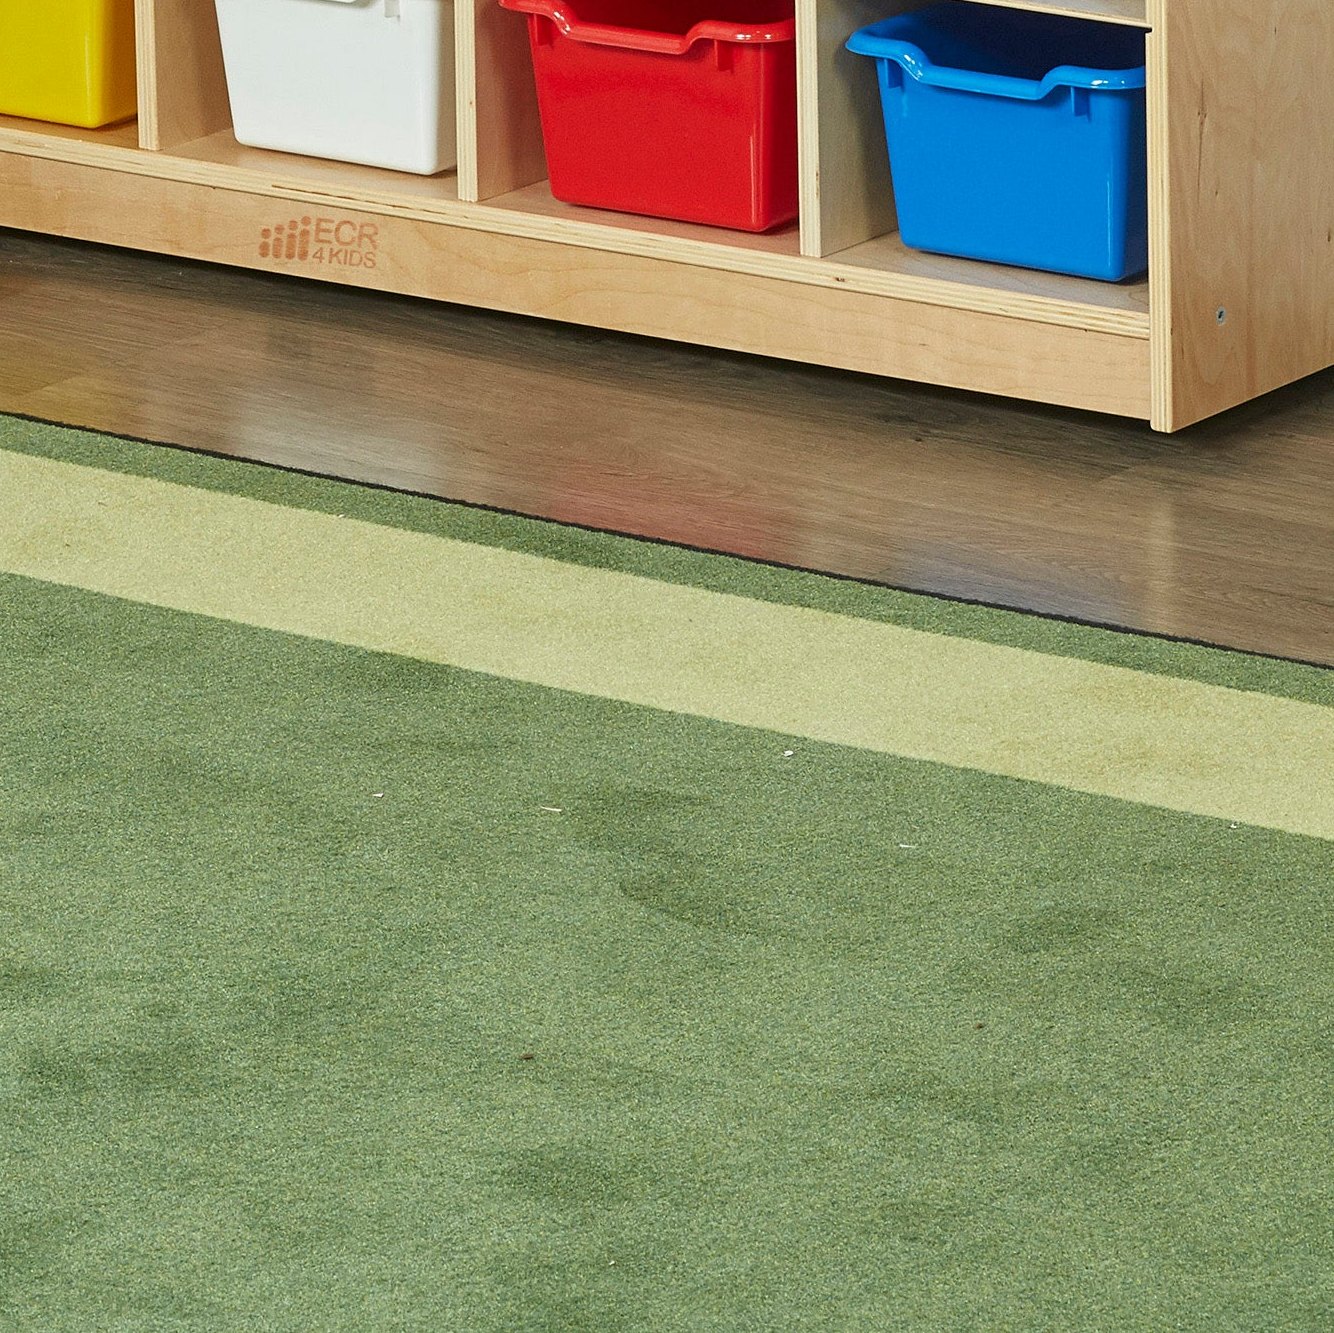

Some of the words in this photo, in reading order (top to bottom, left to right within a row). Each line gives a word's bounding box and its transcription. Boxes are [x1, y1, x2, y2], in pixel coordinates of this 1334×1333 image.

[314, 218, 379, 250] ECR
[312, 247, 325, 264] 4
[328, 248, 377, 269] KIDS
